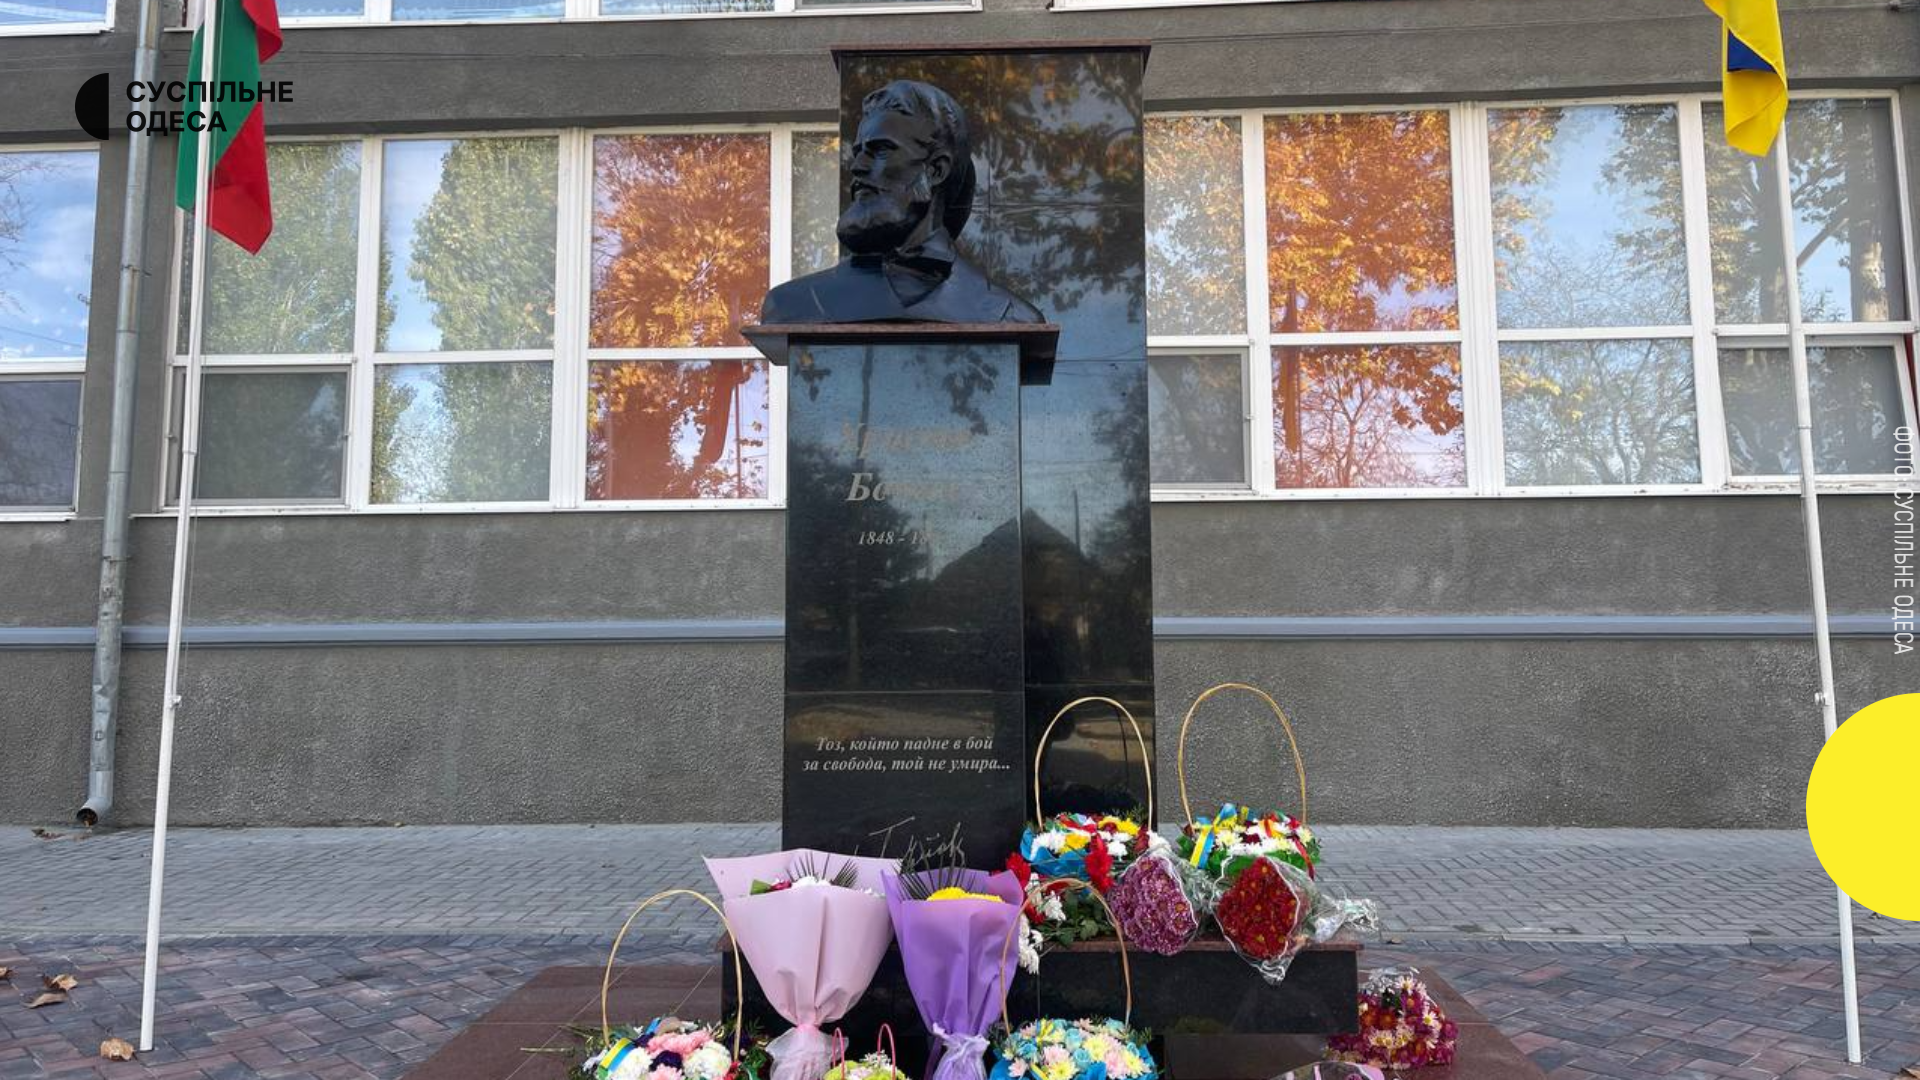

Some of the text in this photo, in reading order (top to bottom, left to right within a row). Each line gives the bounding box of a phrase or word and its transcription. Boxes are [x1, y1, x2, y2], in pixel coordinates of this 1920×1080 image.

[858, 531, 894, 545] 1848
[816, 736, 993, 752] Тоз, който падне в бой
[802, 760, 818, 771] за
[823, 757, 887, 772] свобода,
[891, 757, 923, 771] той
[928, 760, 946, 770] не
